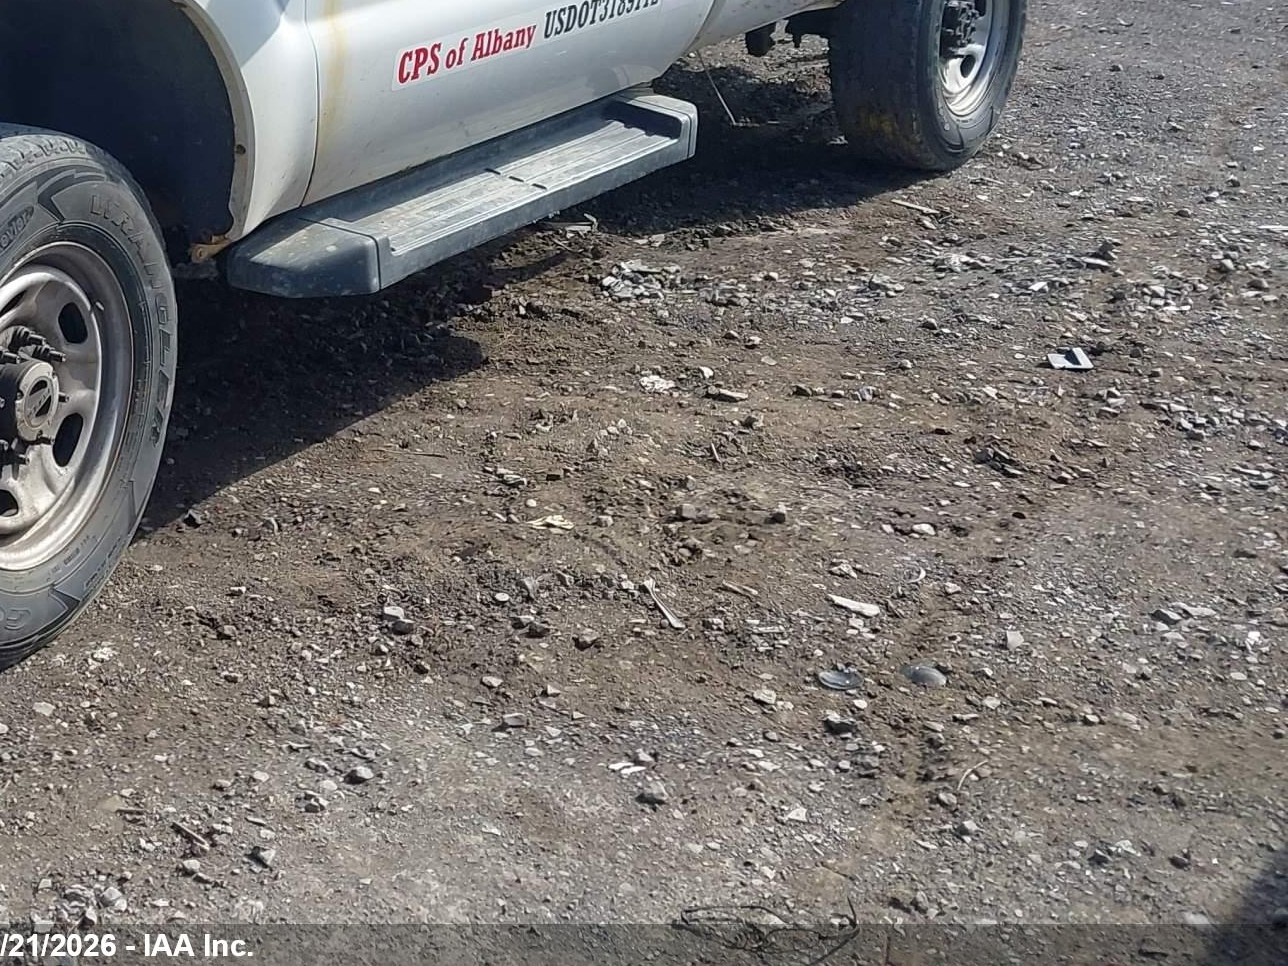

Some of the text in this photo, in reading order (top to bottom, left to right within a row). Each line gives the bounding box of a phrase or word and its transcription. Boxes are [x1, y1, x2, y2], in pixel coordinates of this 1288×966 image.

[398, 43, 441, 85] CPS
[445, 37, 469, 69] of
[471, 24, 537, 61] Albany
